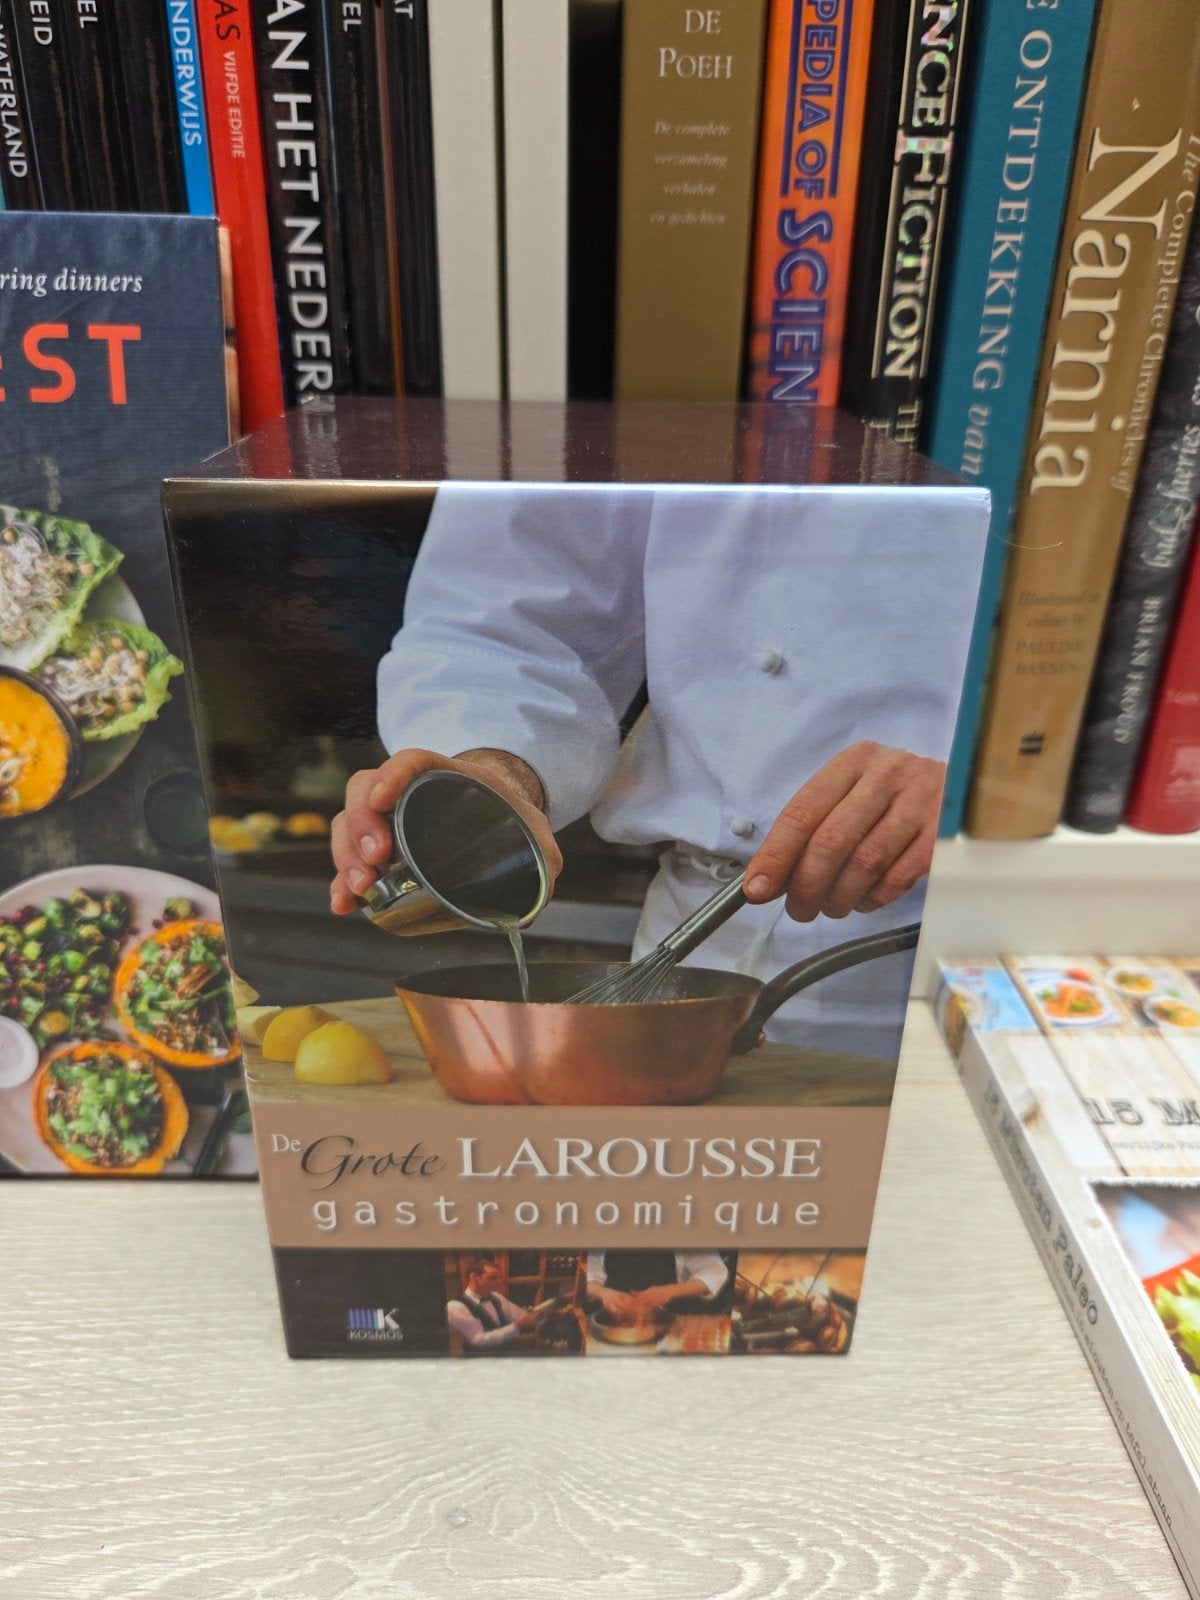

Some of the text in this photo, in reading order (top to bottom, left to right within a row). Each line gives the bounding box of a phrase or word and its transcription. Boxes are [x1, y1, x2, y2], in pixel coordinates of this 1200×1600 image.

[30, 0, 53, 45] EID
[77, 0, 98, 29] EL
[342, 2, 362, 32] EL
[685, 9, 721, 34] DE
[169, 1, 202, 146] NDERWIJS
[222, 51, 241, 104] VIJFDE
[798, 0, 839, 134] PEDIA
[912, 0, 957, 128] NCE
[225, 107, 246, 158] EDITIE
[273, 92, 319, 203] HET
[793, 139, 829, 200] OF
[972, 29, 1053, 391] ONTDEKKING
[53, 267, 143, 293] dinners
[884, 127, 956, 380] FICTION
[1149, 190, 1196, 328] Complete
[284, 217, 336, 405] NEDER
[1030, 126, 1183, 496] Narnia
[0, 323, 142, 405] ST
[1122, 333, 1167, 466] Chronicles
[960, 404, 990, 475] van
[1081, 1098, 1143, 1126] 15
[272, 1133, 823, 1191] De Grote LAROUSSE
[312, 1193, 822, 1234] gastronomique
[1053, 1221, 1099, 1326] Paleo
[1125, 1421, 1147, 1470] tafel
[1147, 1472, 1173, 1528] staan
